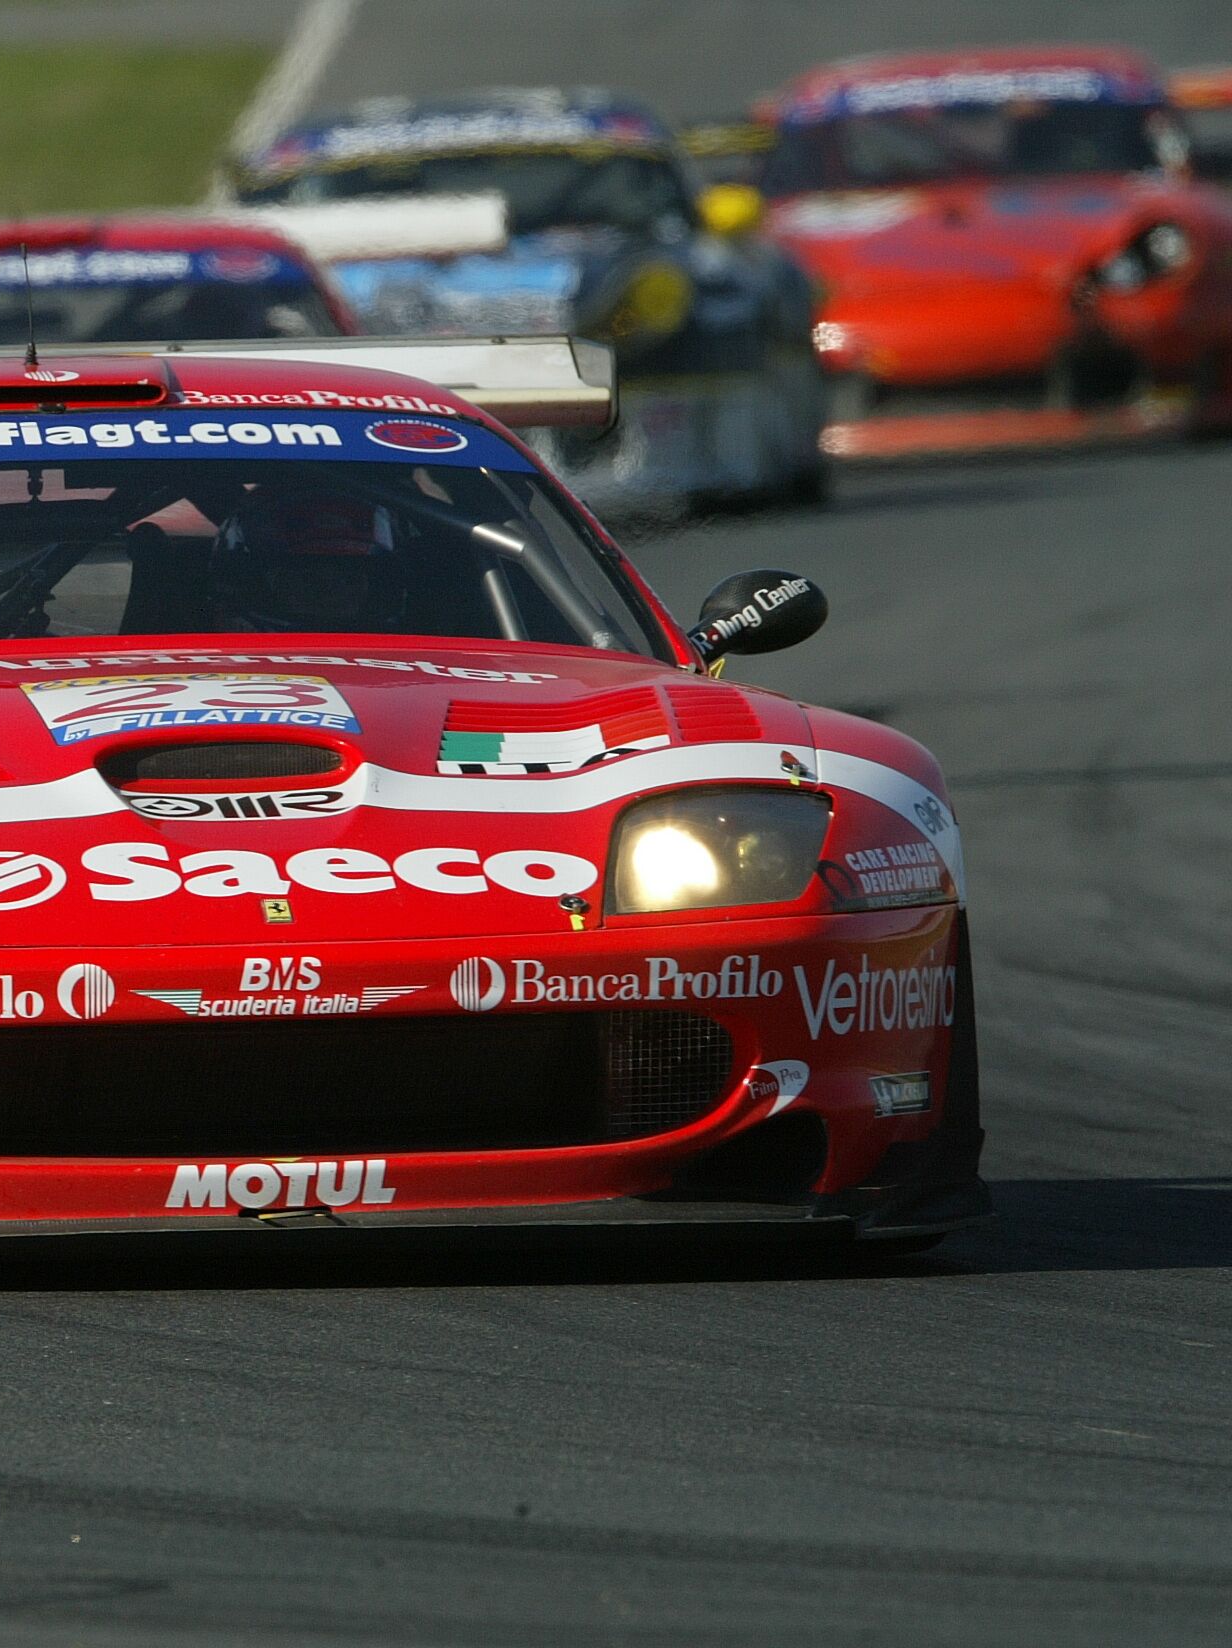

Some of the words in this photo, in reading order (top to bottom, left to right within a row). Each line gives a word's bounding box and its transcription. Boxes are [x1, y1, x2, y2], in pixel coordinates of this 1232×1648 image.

[753, 578, 812, 612] Center
[52, 682, 329, 724] 23
[118, 709, 351, 731] FILLATTICE
[80, 842, 599, 901] Saeco
[844, 847, 890, 873] CARE
[886, 842, 936, 867] RACING
[859, 865, 942, 895] DEVELOPMENT
[239, 956, 322, 992] BMS
[198, 994, 296, 1017] scuderia
[302, 993, 360, 1014] italia
[792, 948, 956, 1041] Vetroresina
[164, 1159, 397, 1209] MOTUL
